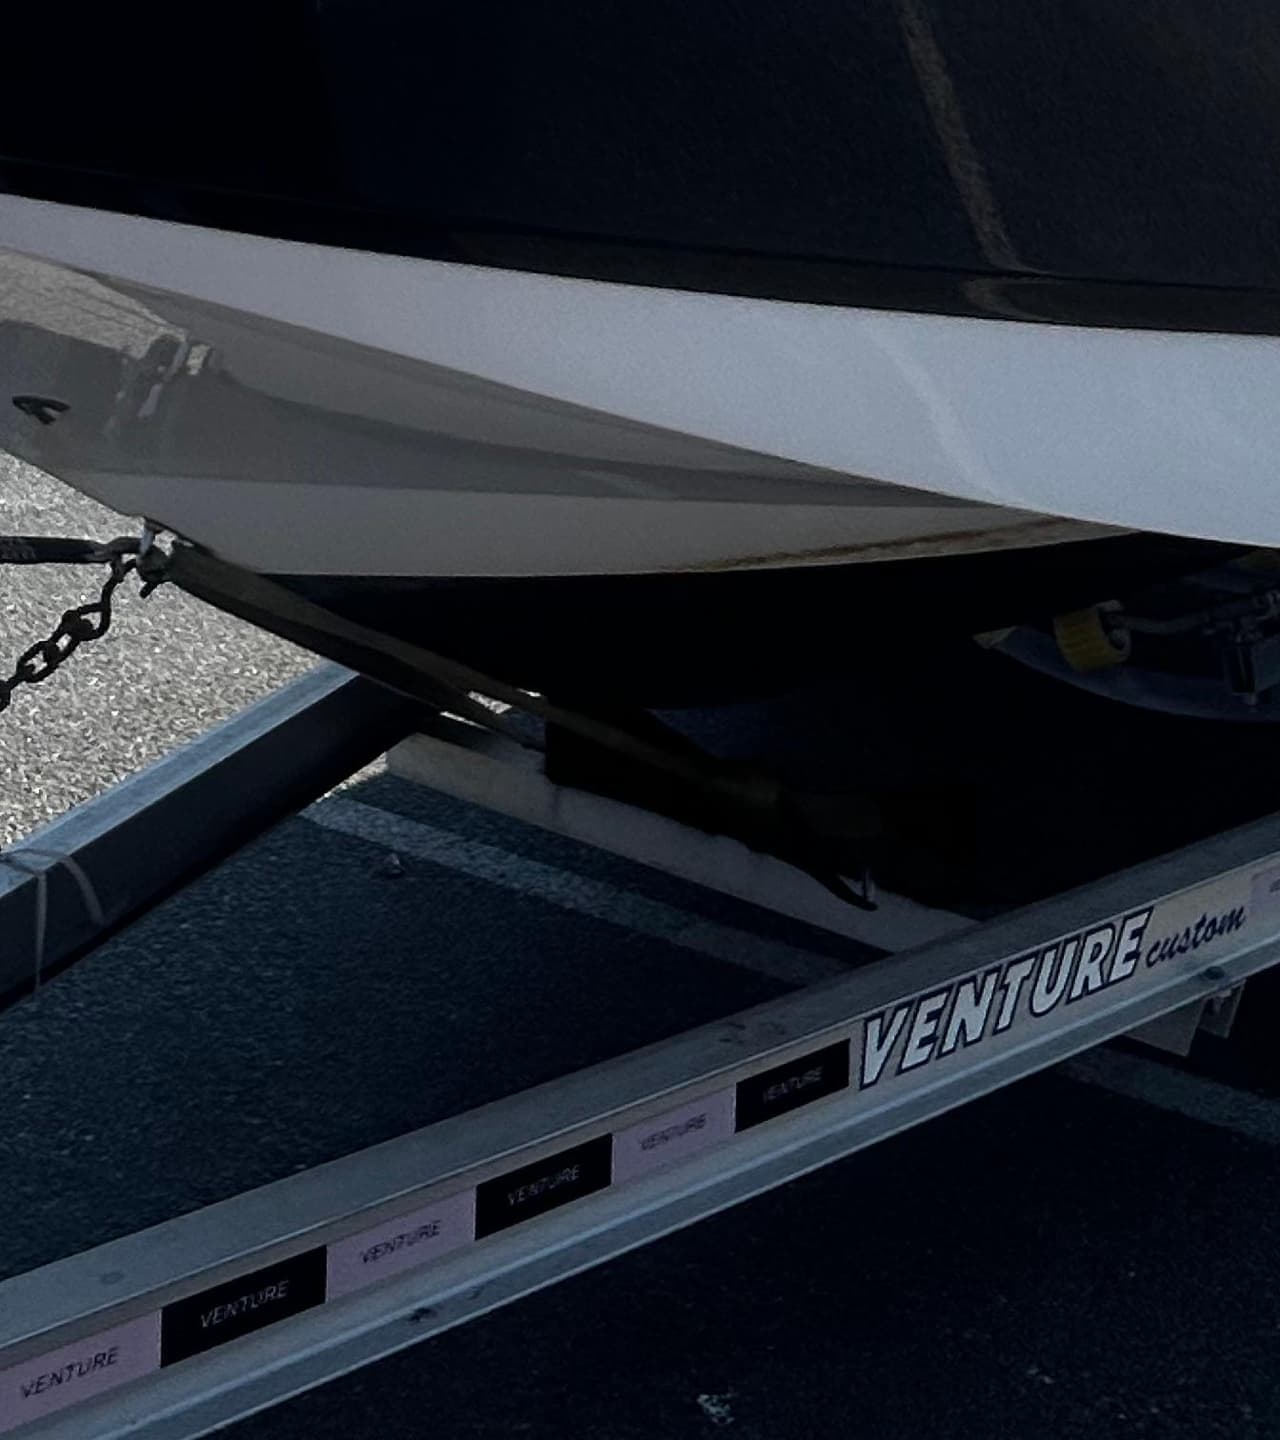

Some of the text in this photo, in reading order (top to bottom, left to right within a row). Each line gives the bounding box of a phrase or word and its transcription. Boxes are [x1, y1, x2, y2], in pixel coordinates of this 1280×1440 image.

[860, 907, 1246, 1090] VENTURE custom
[508, 1164, 580, 1207] VENTURE
[360, 1222, 441, 1264] VENTURE
[200, 1281, 289, 1329] VENTURE
[21, 1348, 120, 1399] VENTURE
